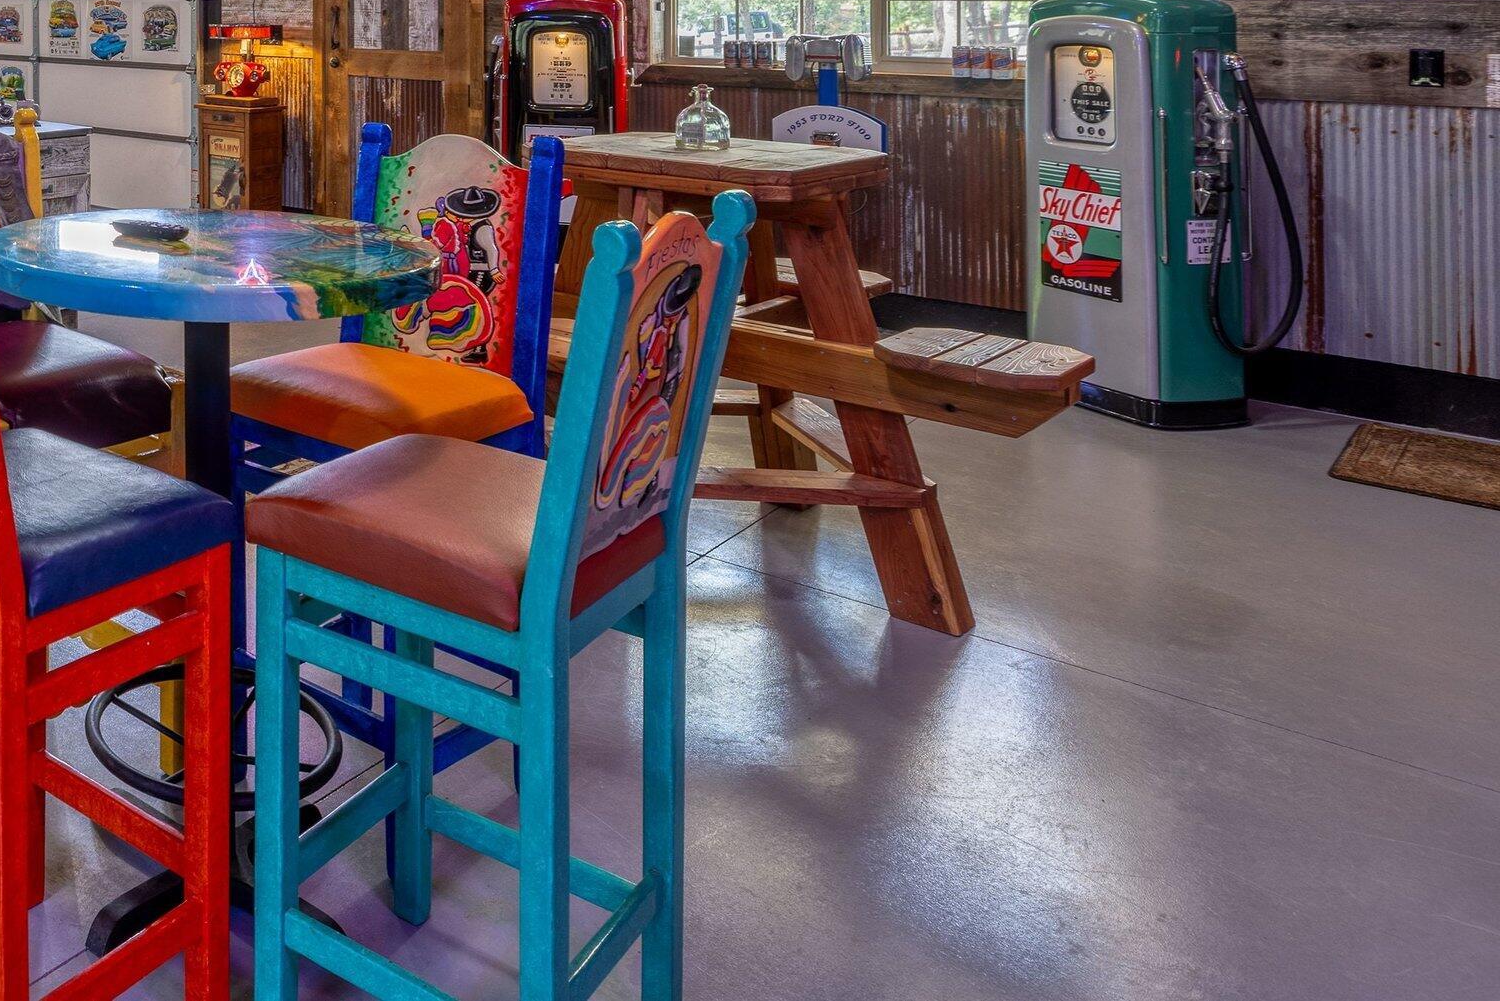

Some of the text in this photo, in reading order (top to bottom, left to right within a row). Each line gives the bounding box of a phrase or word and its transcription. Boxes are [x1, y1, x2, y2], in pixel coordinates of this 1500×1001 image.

[1073, 98, 1090, 106] THIS
[786, 113, 872, 141] 1953 FORD F100
[1040, 187, 1121, 225] Sky Chief
[645, 226, 700, 282] Fiestas
[1051, 274, 1113, 296] GASOLINE
